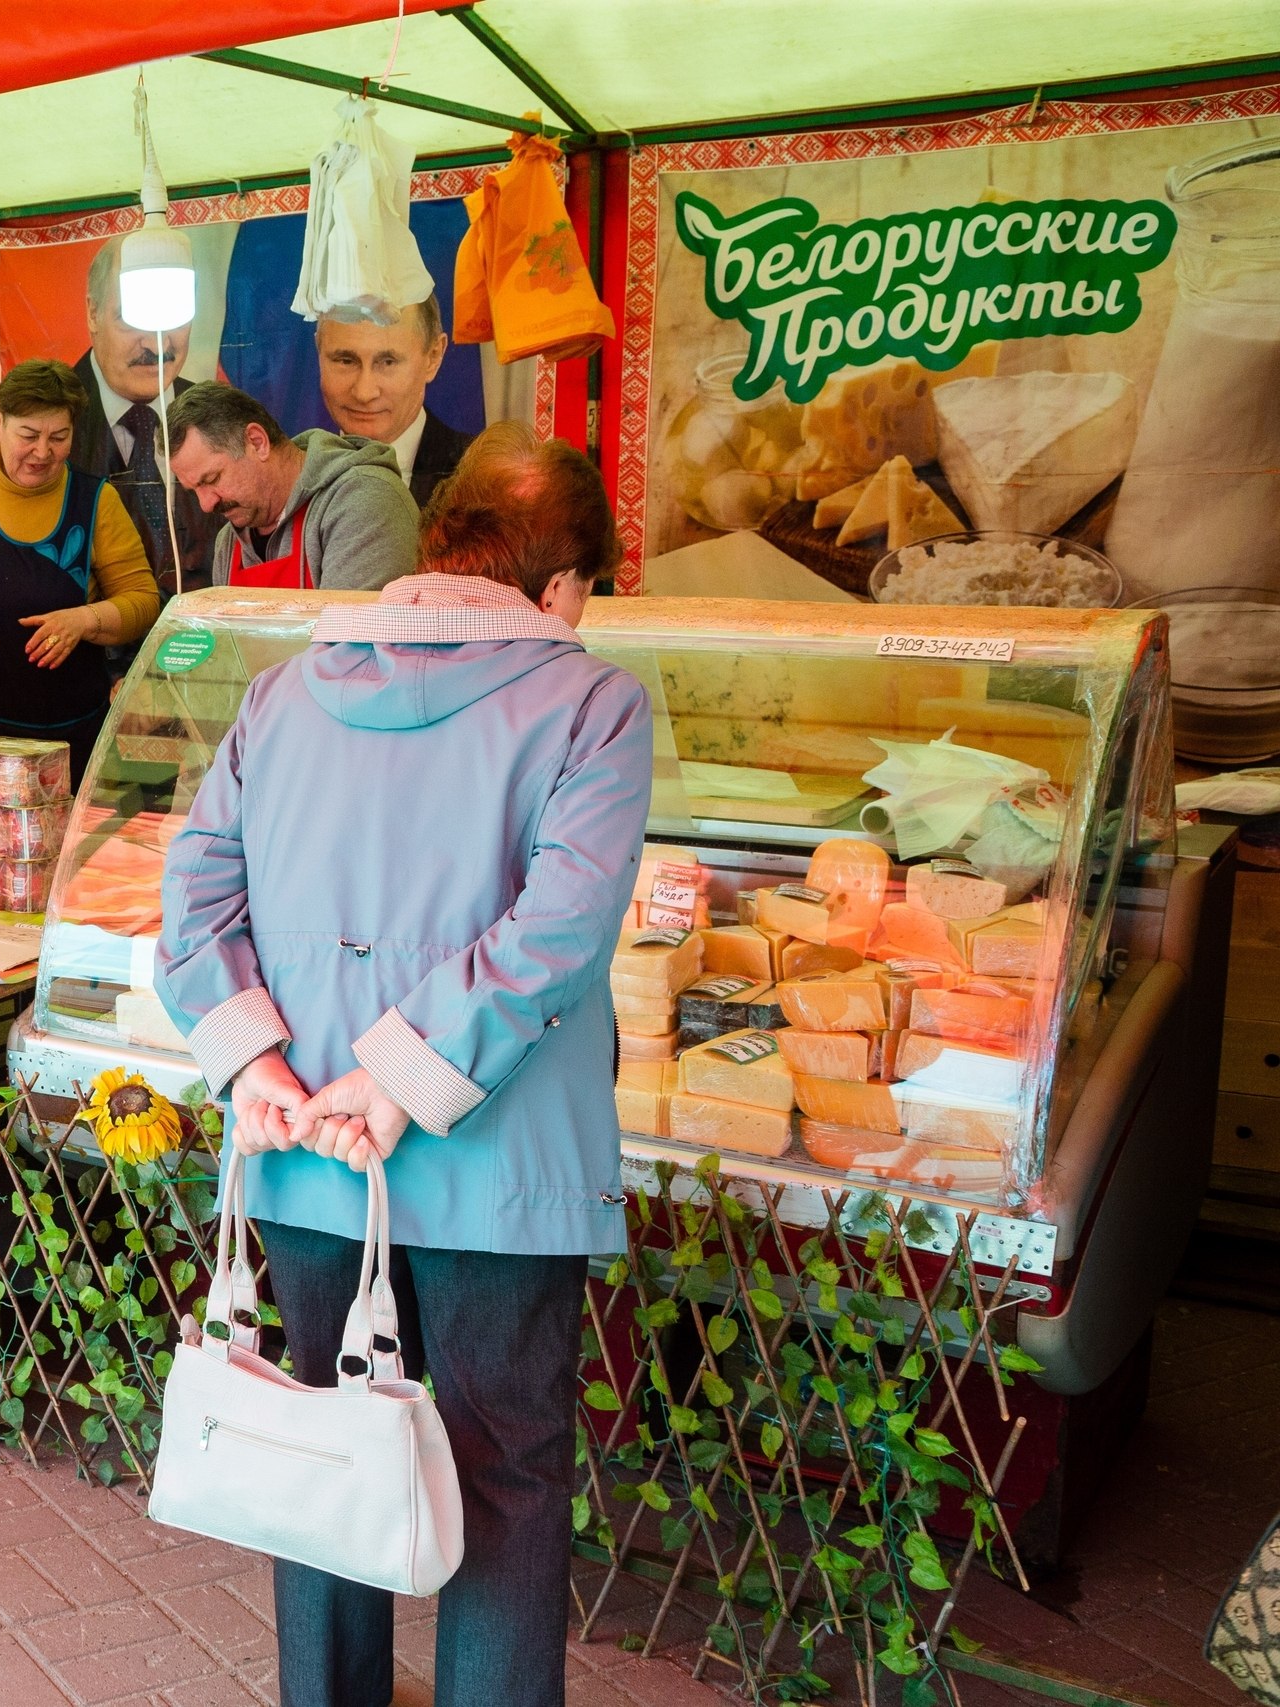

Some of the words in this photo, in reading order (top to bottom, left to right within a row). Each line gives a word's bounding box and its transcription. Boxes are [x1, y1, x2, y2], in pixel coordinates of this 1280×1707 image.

[684, 203, 1160, 302] Белорусские
[746, 274, 1125, 386] Продукты
[880, 636, 1011, 658] 8-909-37-47-242
